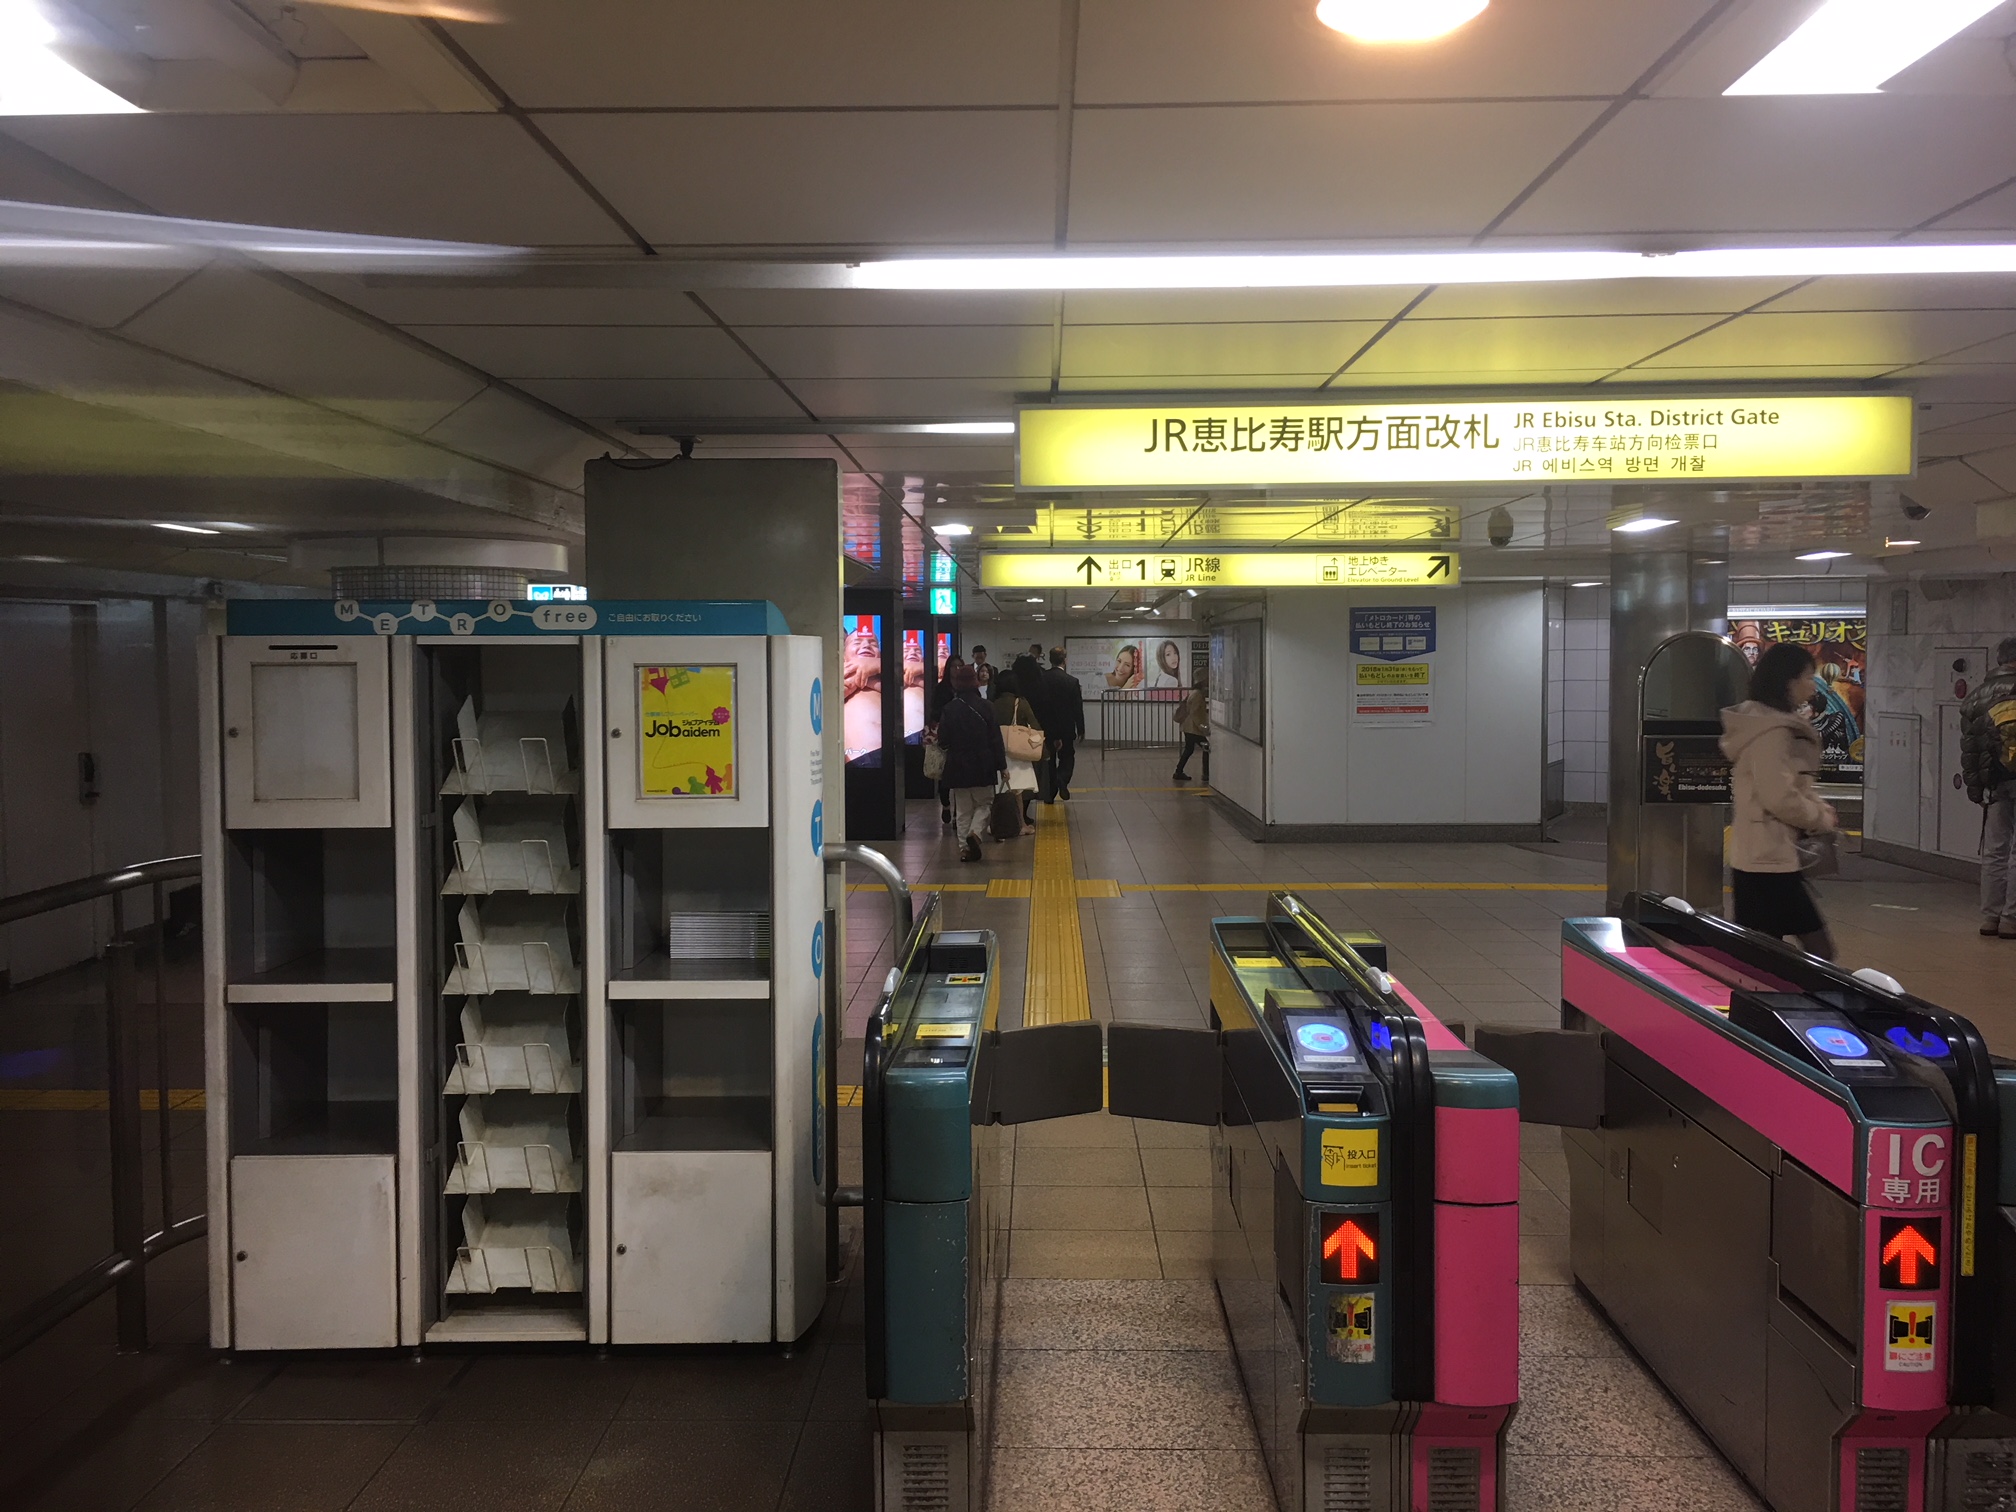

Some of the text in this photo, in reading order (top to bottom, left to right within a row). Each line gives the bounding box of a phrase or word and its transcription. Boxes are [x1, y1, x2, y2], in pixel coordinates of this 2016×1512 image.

[1514, 408, 1780, 429] JR Ebisu Sta. District Gate
[1144, 413, 1501, 453] JR恵比寿駅方面改札
[1513, 433, 1718, 453] JR惠比寿车站方向检票口
[1513, 455, 1706, 473] JR 에비스역 방면 개찰
[1108, 559, 1146, 581] 出口 1
[1186, 557, 1221, 573] JR線
[1348, 556, 1389, 566] 地上ゆき
[1185, 574, 1216, 582] JR Line
[1348, 567, 1407, 577] エレベーター
[542, 609, 588, 623] free
[608, 613, 702, 622] ご自由にお取りください
[645, 720, 720, 738] Job aidem
[1347, 1149, 1376, 1160] 投入口
[1889, 1133, 1945, 1177] IC
[1881, 1177, 1940, 1204] 専用
